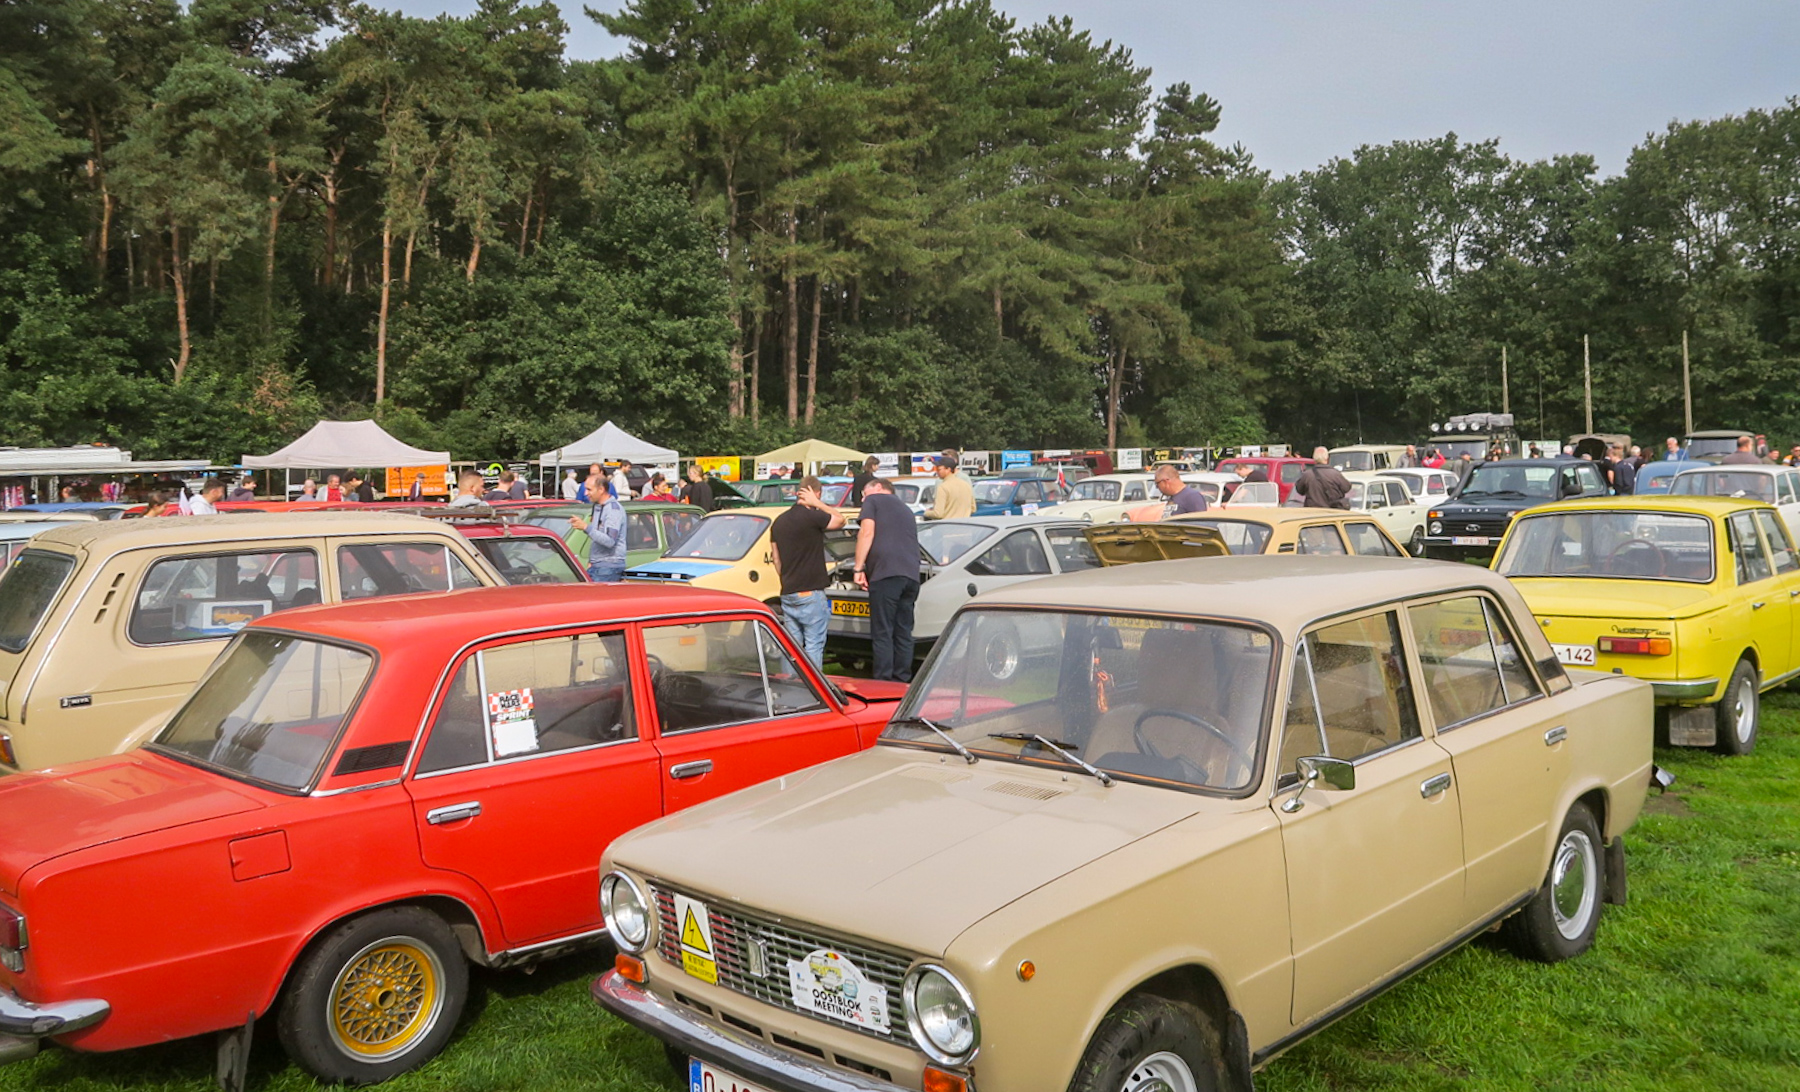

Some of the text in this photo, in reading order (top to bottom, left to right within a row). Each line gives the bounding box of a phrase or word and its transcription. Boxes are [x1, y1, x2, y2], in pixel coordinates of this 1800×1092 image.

[497, 709, 531, 722] SPRINT
[812, 988, 862, 1012] OOSTBLOK
[814, 999, 854, 1019] MEETING
